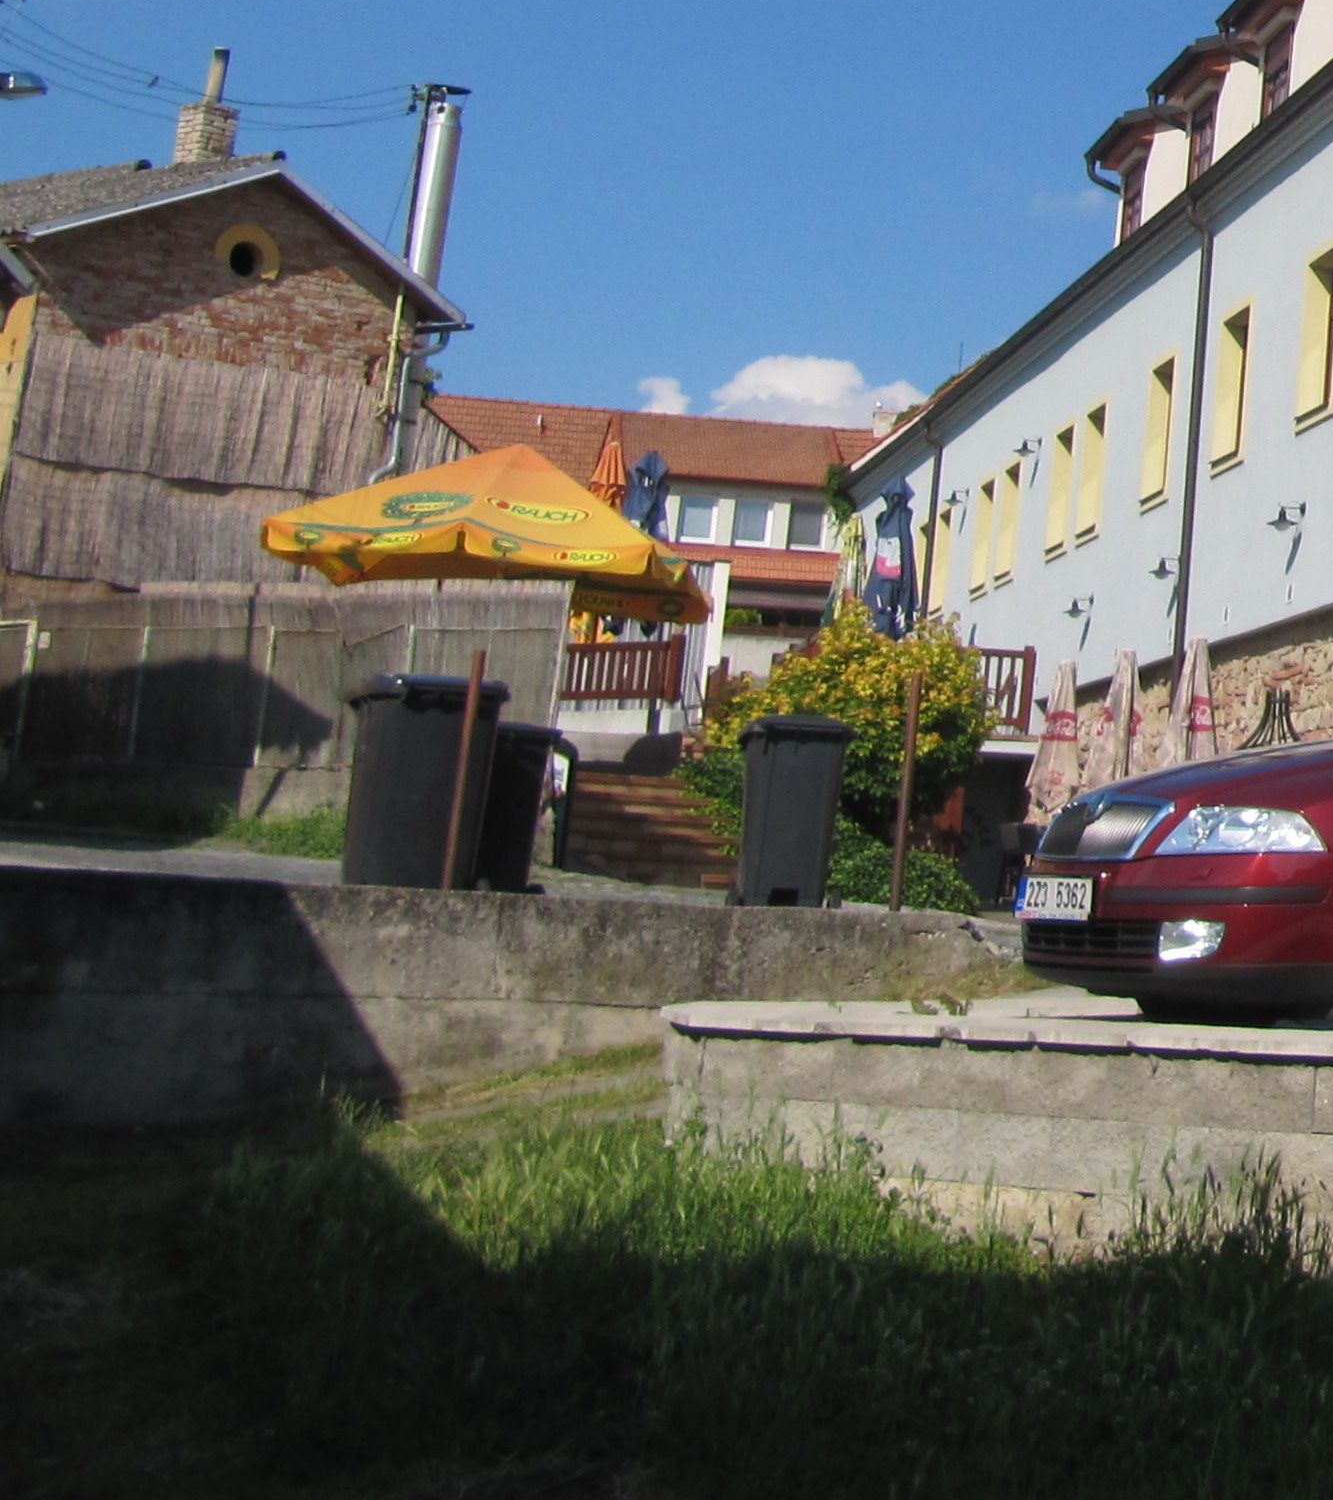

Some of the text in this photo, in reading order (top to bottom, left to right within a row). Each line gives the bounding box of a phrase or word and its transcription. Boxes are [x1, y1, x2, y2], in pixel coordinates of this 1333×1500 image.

[510, 505, 579, 522] RAUCH
[569, 551, 611, 562] RAUCH
[1056, 882, 1087, 910] 5362
